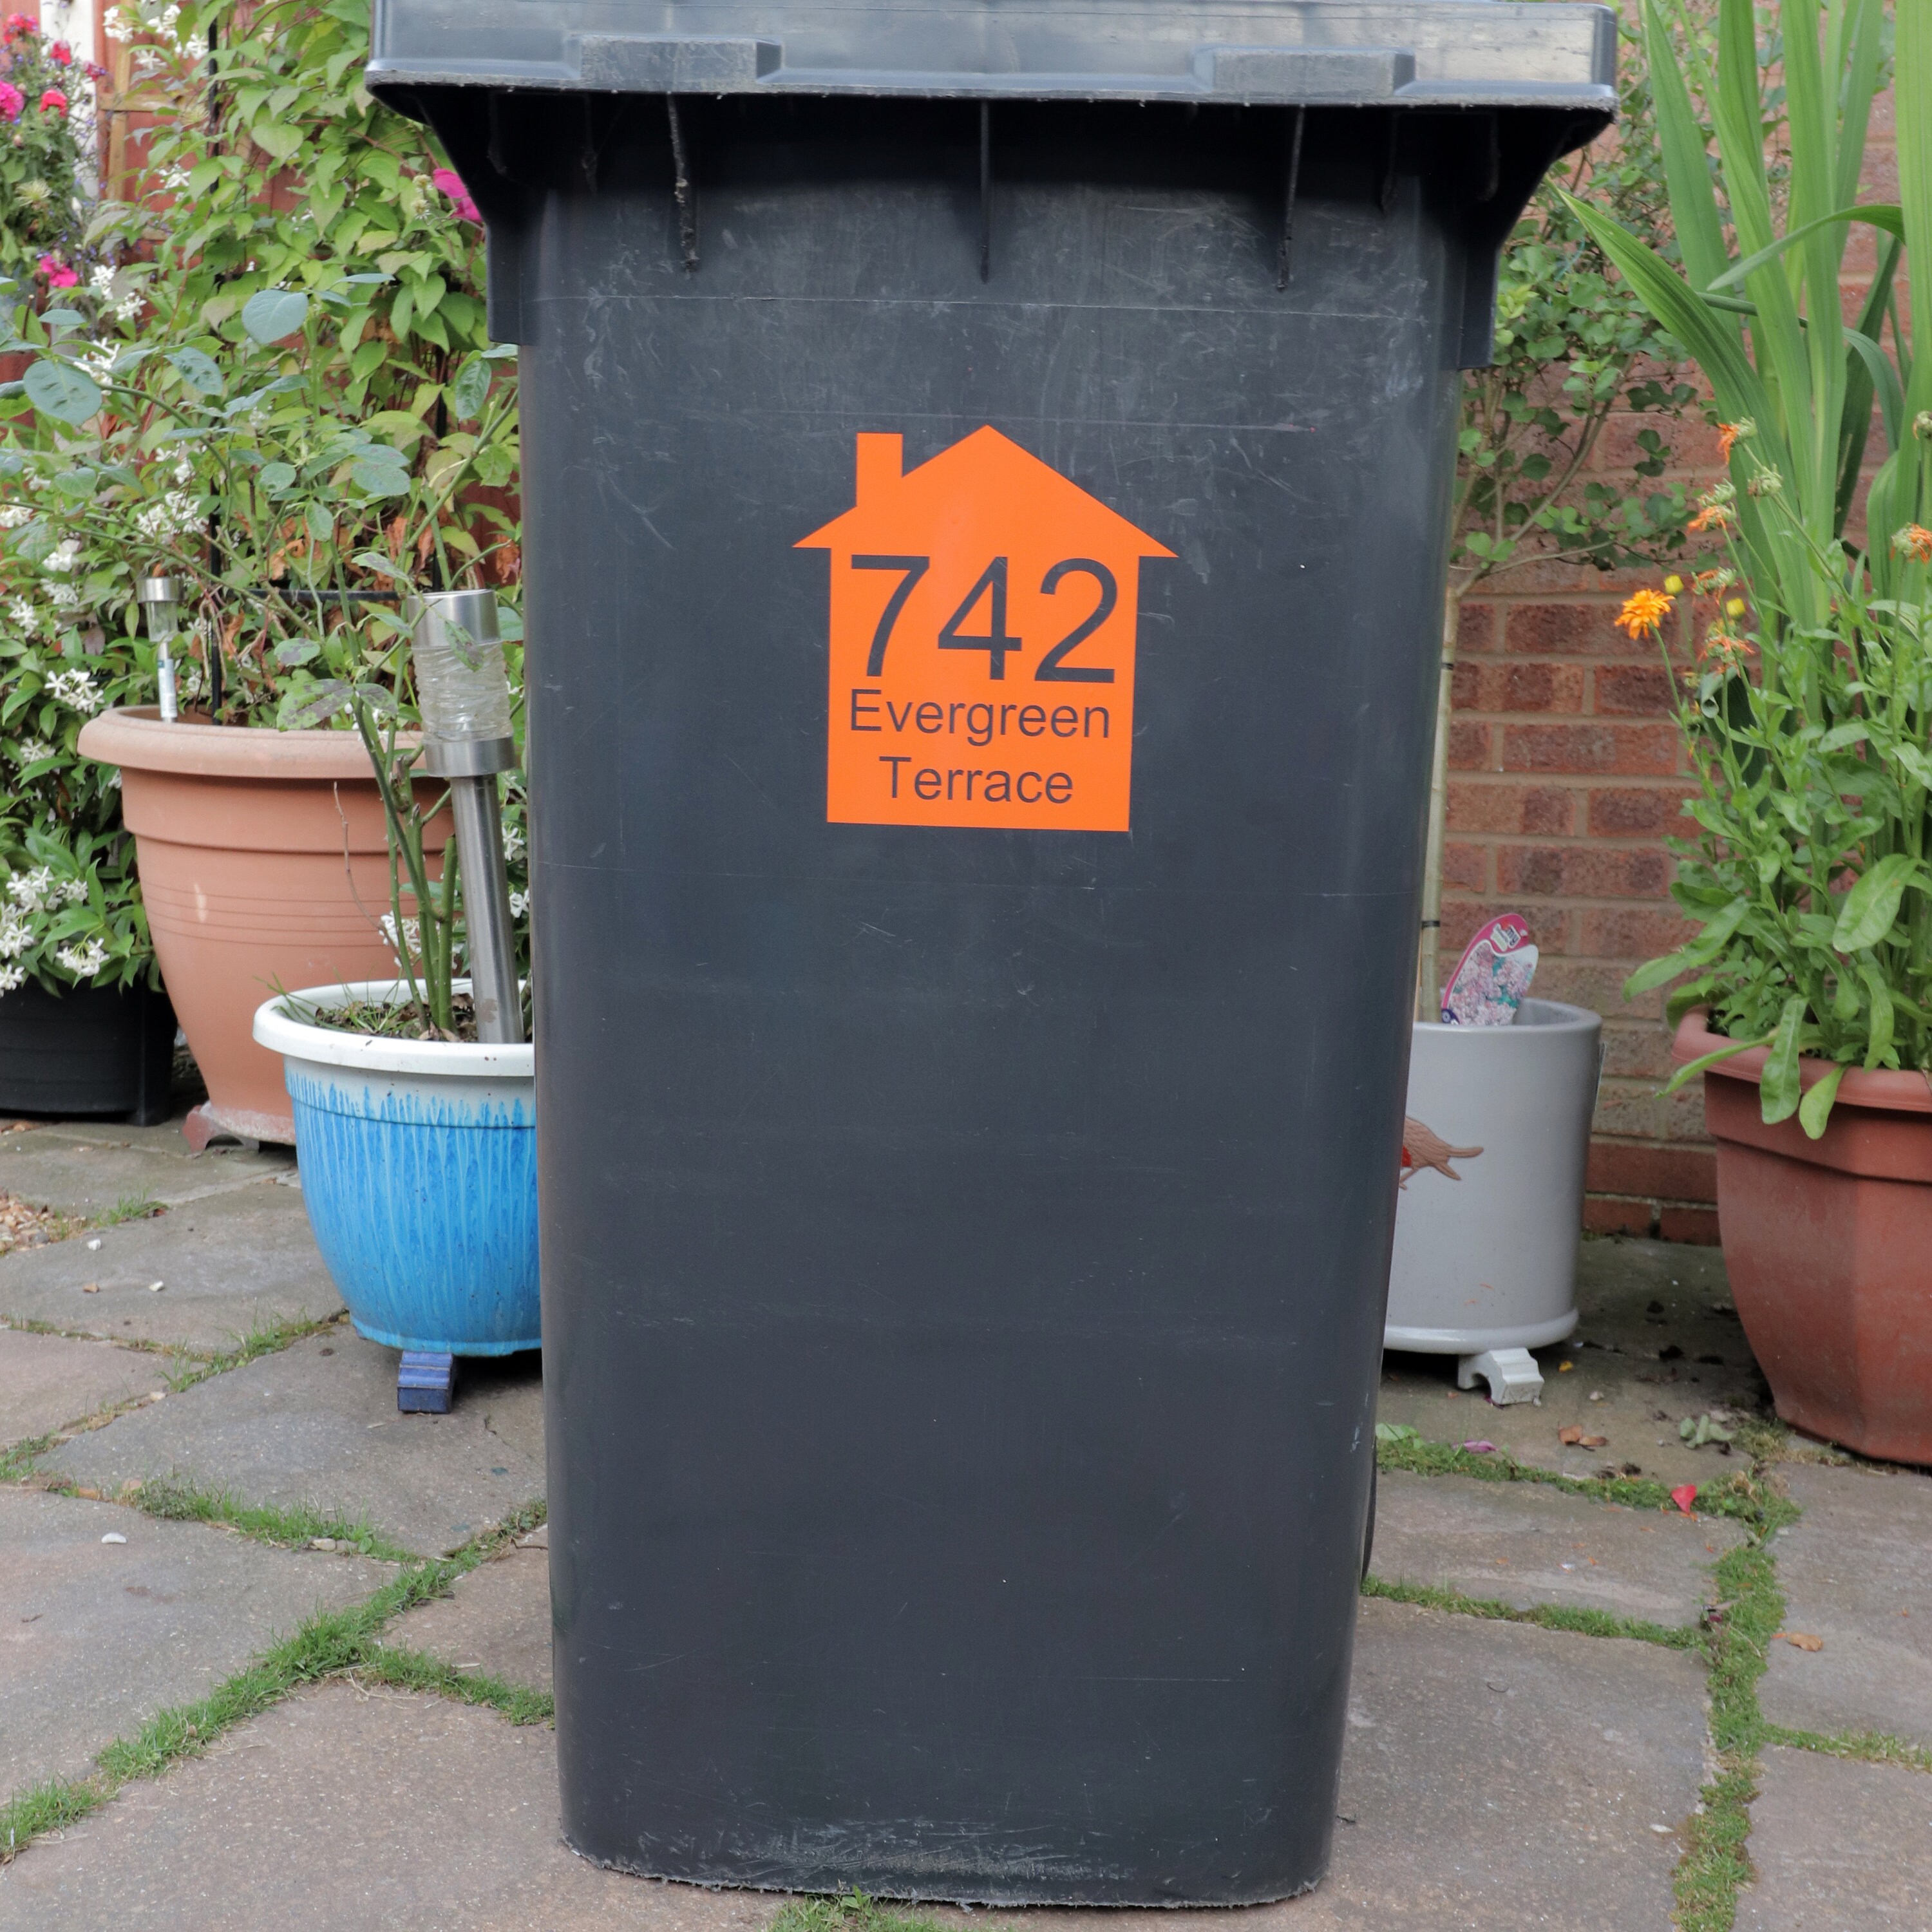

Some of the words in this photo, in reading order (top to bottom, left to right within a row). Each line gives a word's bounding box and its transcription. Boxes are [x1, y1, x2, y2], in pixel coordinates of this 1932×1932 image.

[851, 554, 1117, 683] 742
[851, 688, 1110, 746] Evergreen
[879, 755, 1073, 803] Terrace
